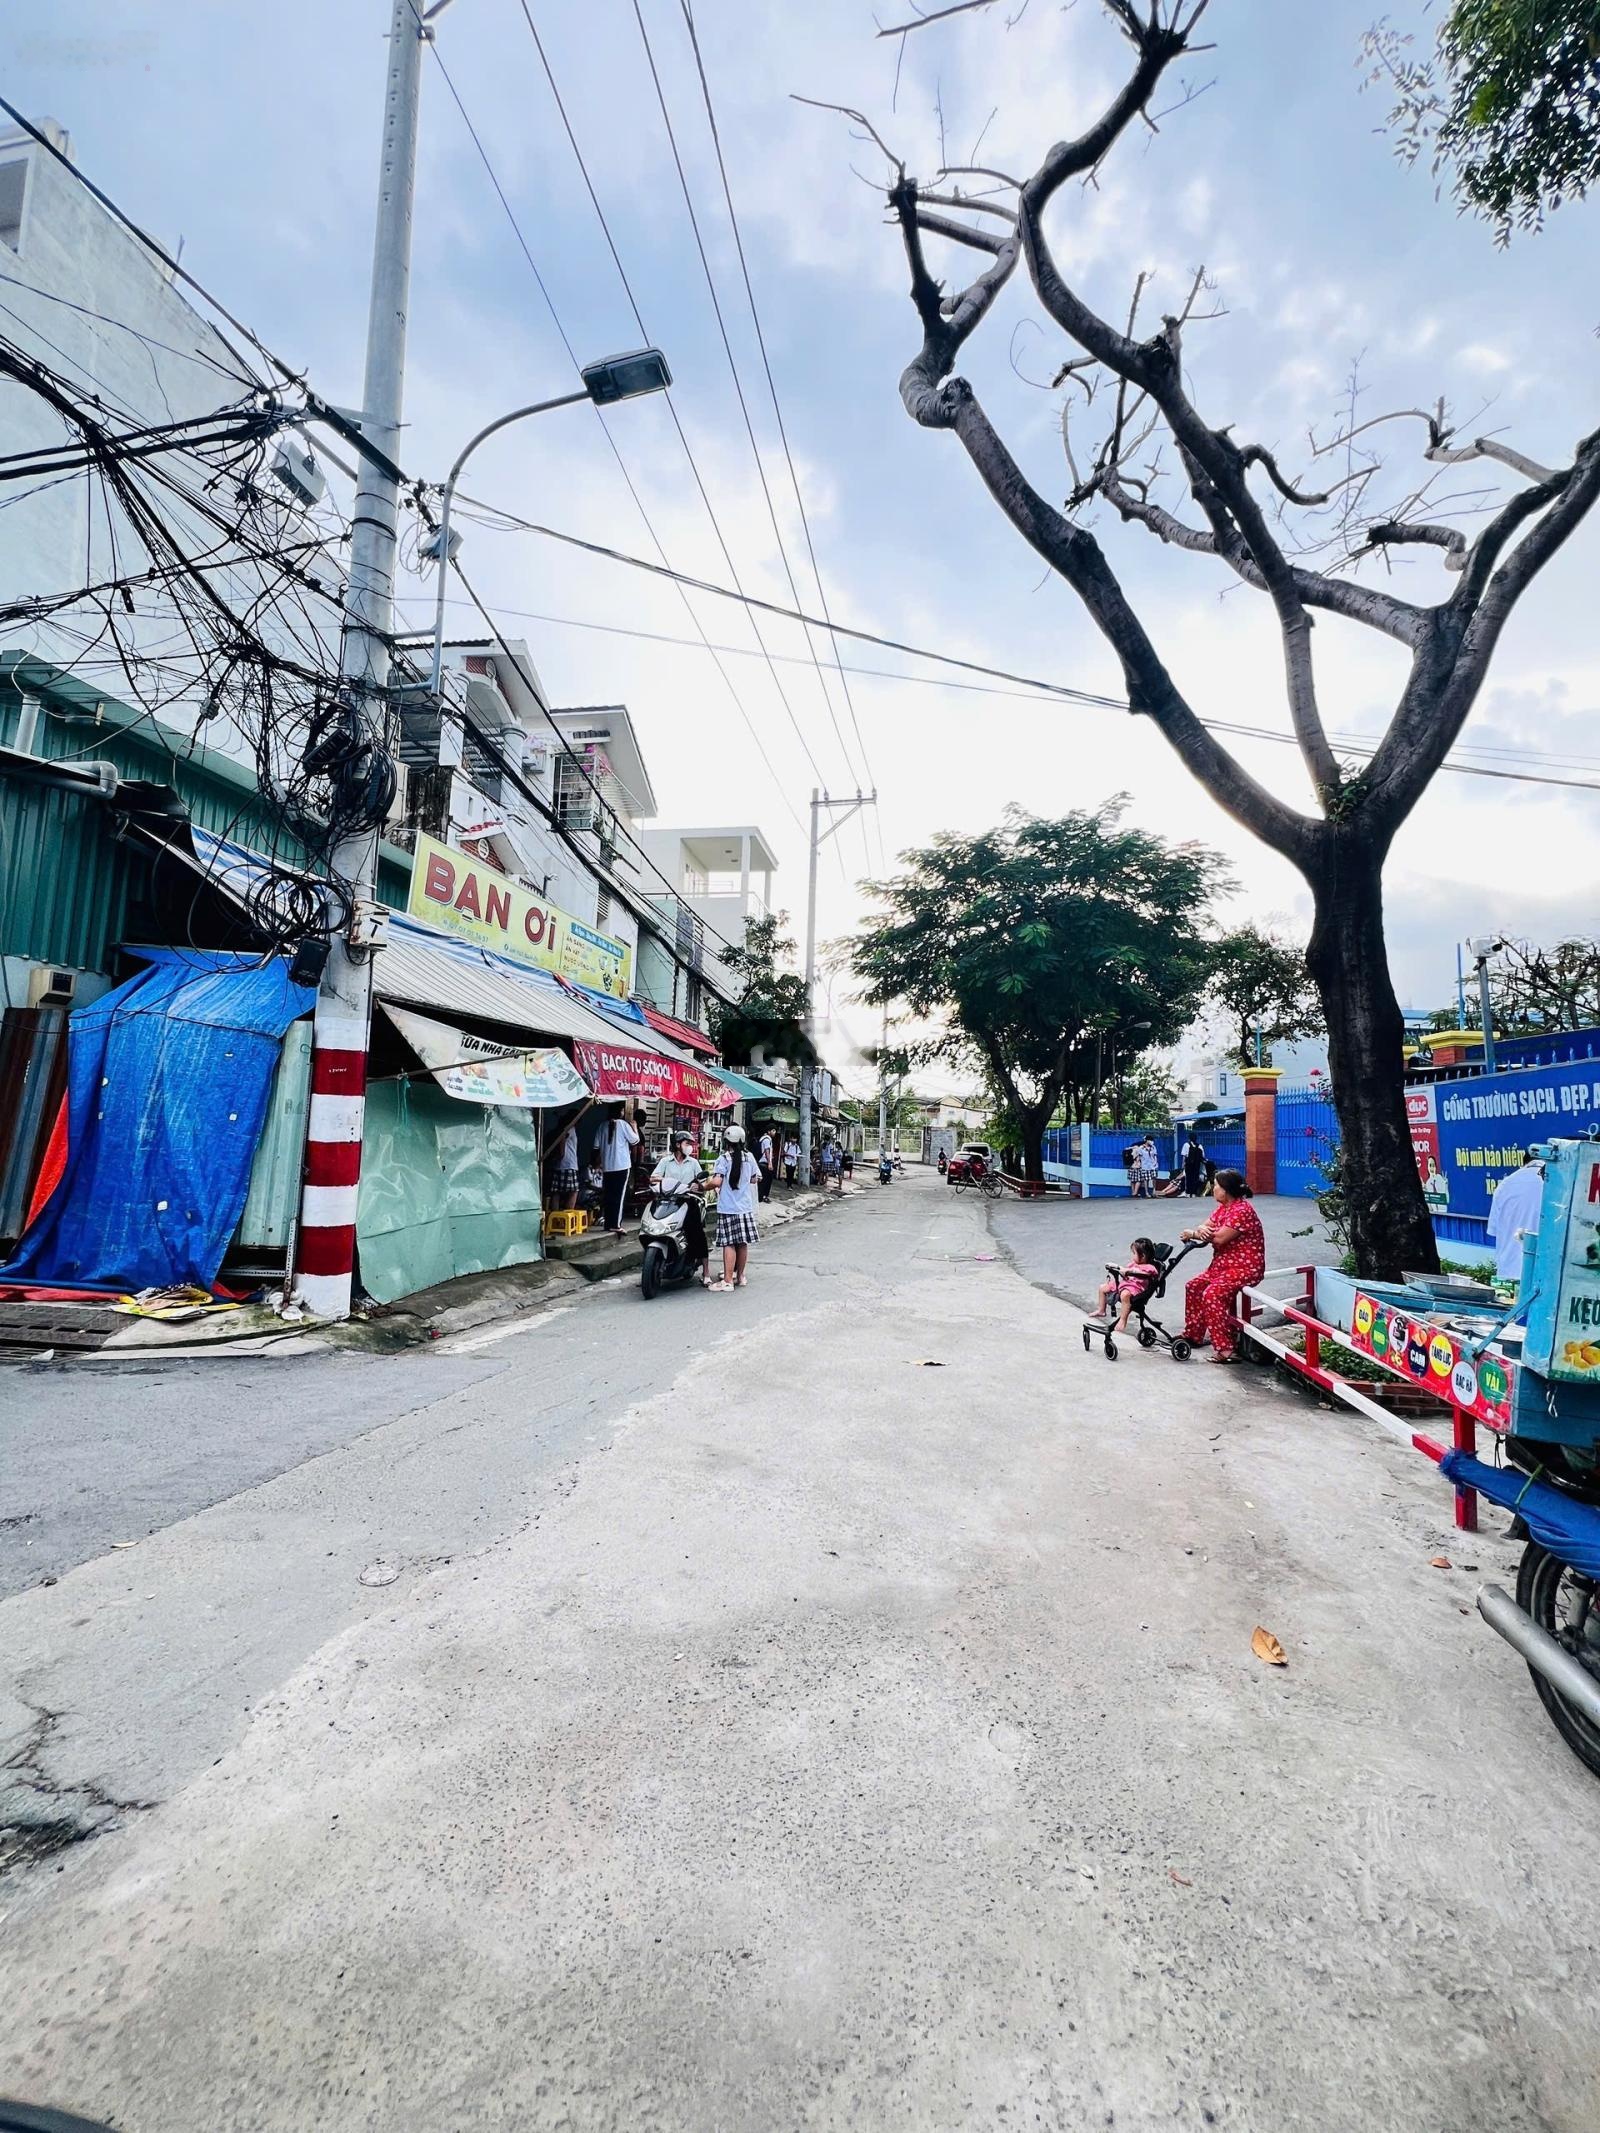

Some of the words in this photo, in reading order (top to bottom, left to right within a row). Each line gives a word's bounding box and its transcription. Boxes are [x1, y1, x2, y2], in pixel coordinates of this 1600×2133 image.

[425, 852, 511, 931] BẠN
[601, 1052, 628, 1072] BACK
[629, 1057, 641, 1074] TO
[1443, 1093, 1471, 1121] CỔNG
[1472, 1090, 1518, 1119] TRƯỜNG
[1520, 1087, 1559, 1120] SẠCH,
[1561, 1083, 1591, 1116] ĐẸP,
[1470, 1146, 1483, 1166] mũ
[1484, 1144, 1501, 1167] bảo
